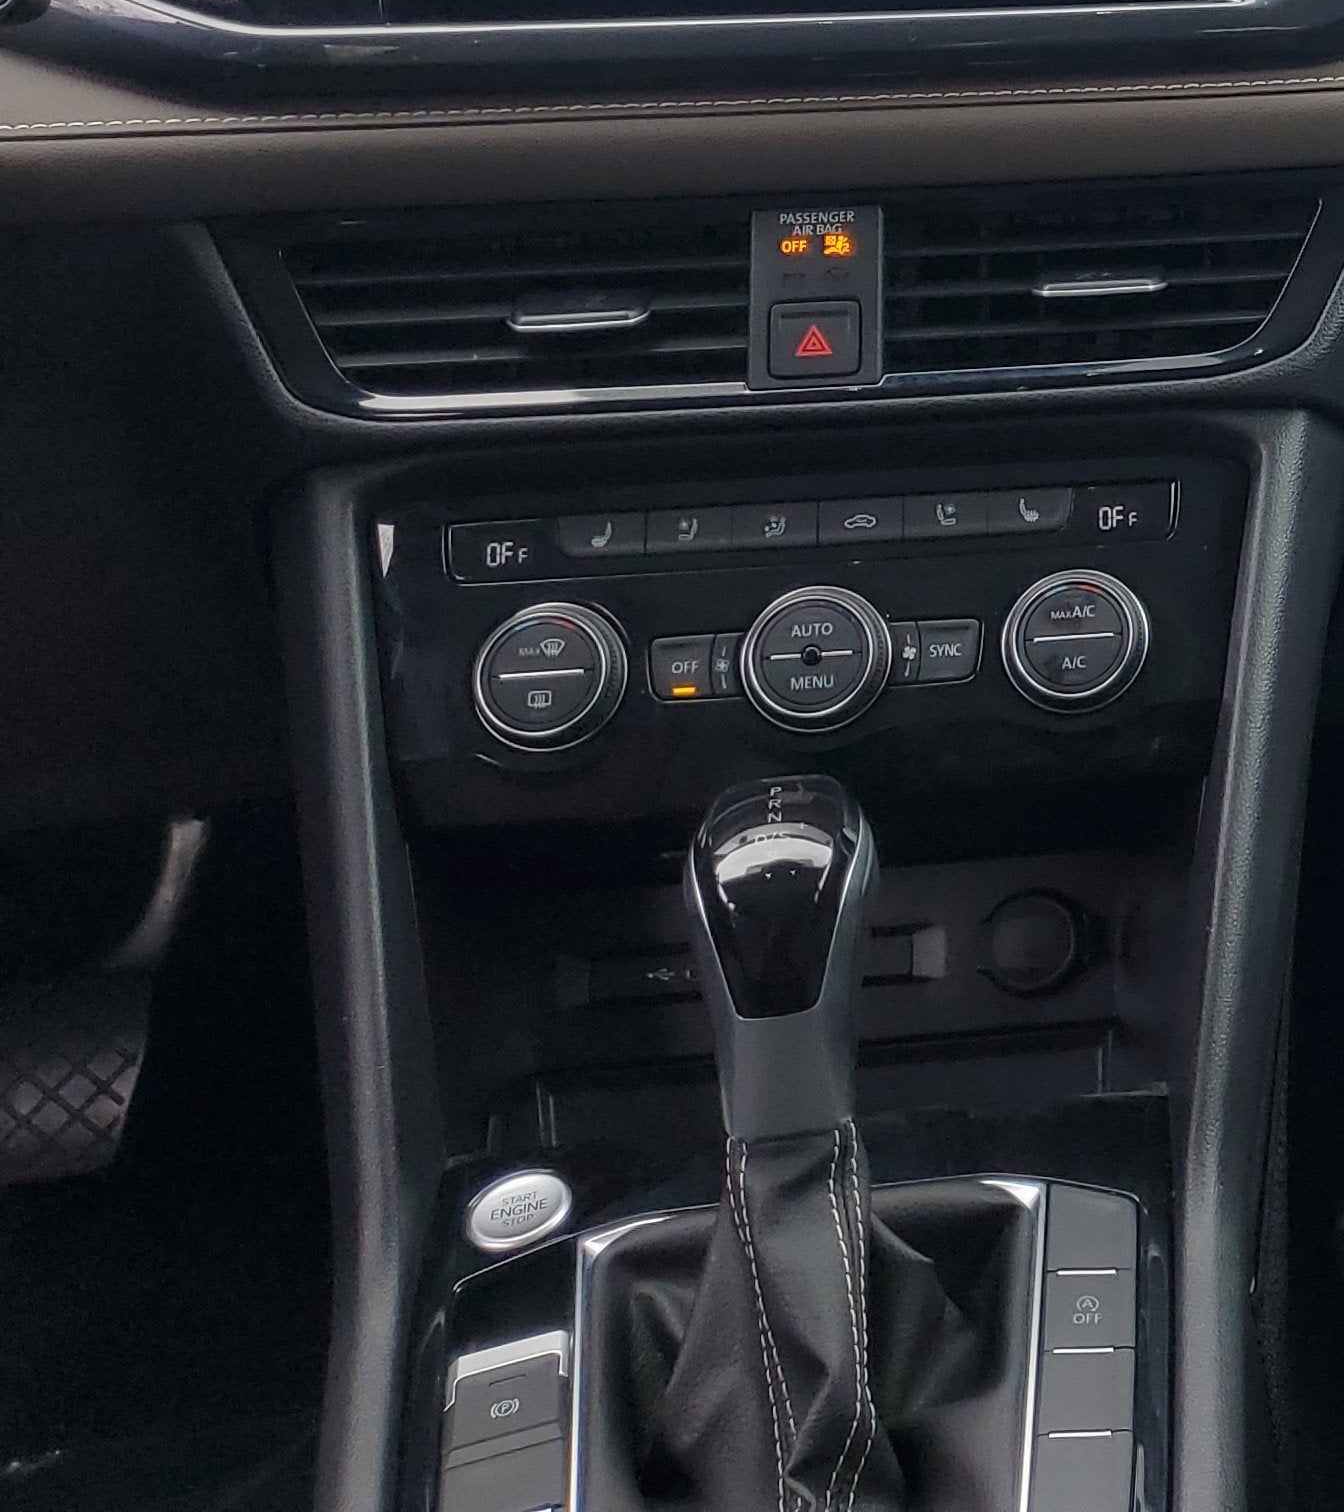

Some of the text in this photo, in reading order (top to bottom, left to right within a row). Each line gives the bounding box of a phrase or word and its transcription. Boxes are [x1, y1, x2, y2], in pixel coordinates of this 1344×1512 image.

[779, 210, 855, 225] PASSENGER
[792, 223, 843, 236] AIR BAG
[781, 239, 808, 253] OFF
[790, 621, 834, 639] AUTO
[929, 642, 963, 658] SYNC
[671, 660, 700, 675] OFF
[1061, 655, 1087, 671] A/C
[790, 673, 835, 692] MENU
[770, 786, 783, 797] P
[768, 798, 782, 810] R
[767, 811, 783, 824] N
[502, 1190, 539, 1207] START
[490, 1197, 549, 1221] ENGINE
[502, 1212, 535, 1228] STOP
[1072, 1311, 1102, 1326] OFF
